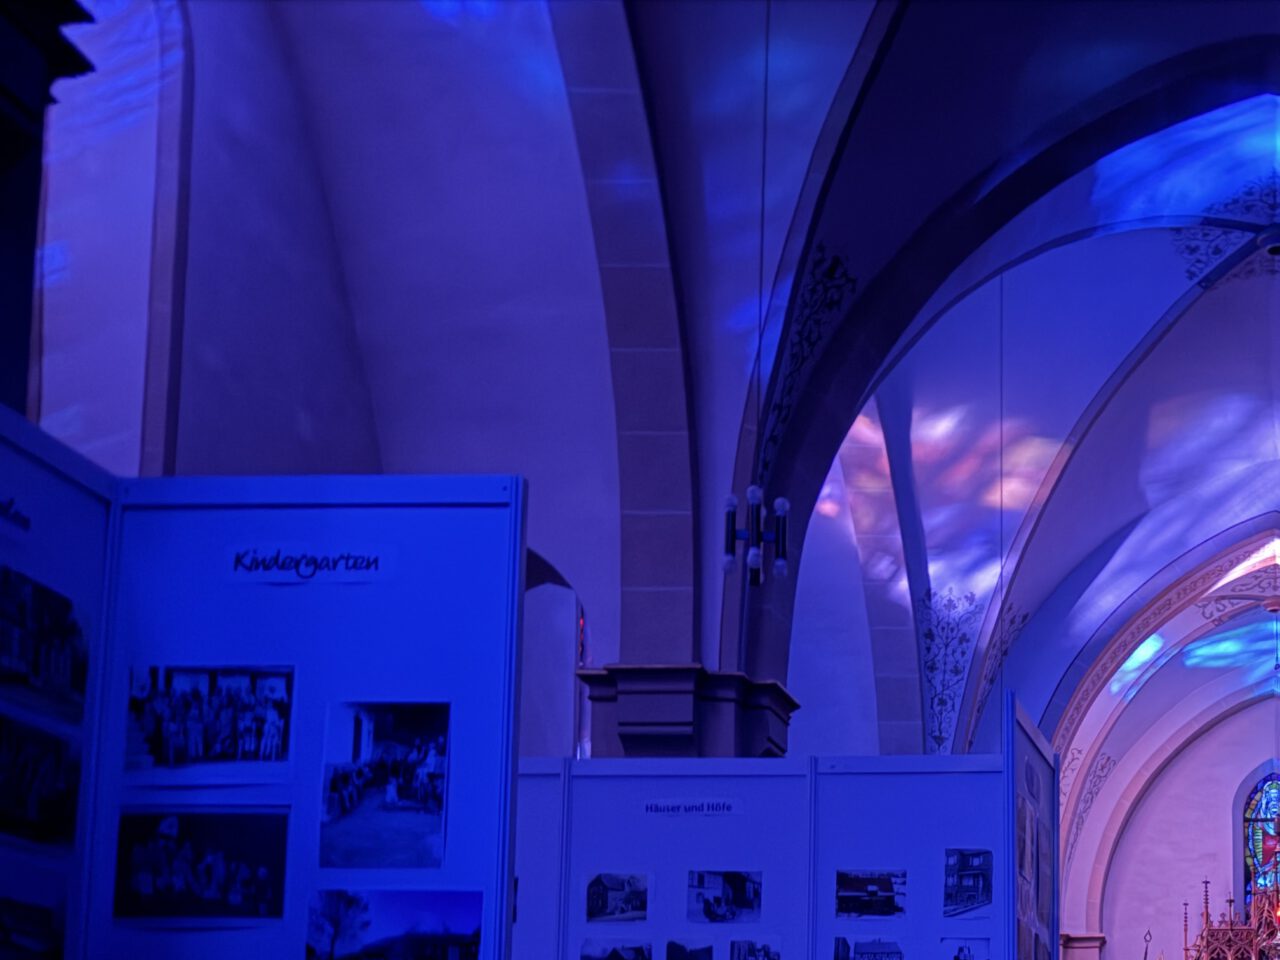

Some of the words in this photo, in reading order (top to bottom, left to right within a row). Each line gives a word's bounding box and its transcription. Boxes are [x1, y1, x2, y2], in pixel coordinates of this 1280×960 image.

[233, 549, 379, 579] Kindergarten
[645, 803, 681, 813] Häuser
[683, 803, 704, 813] und
